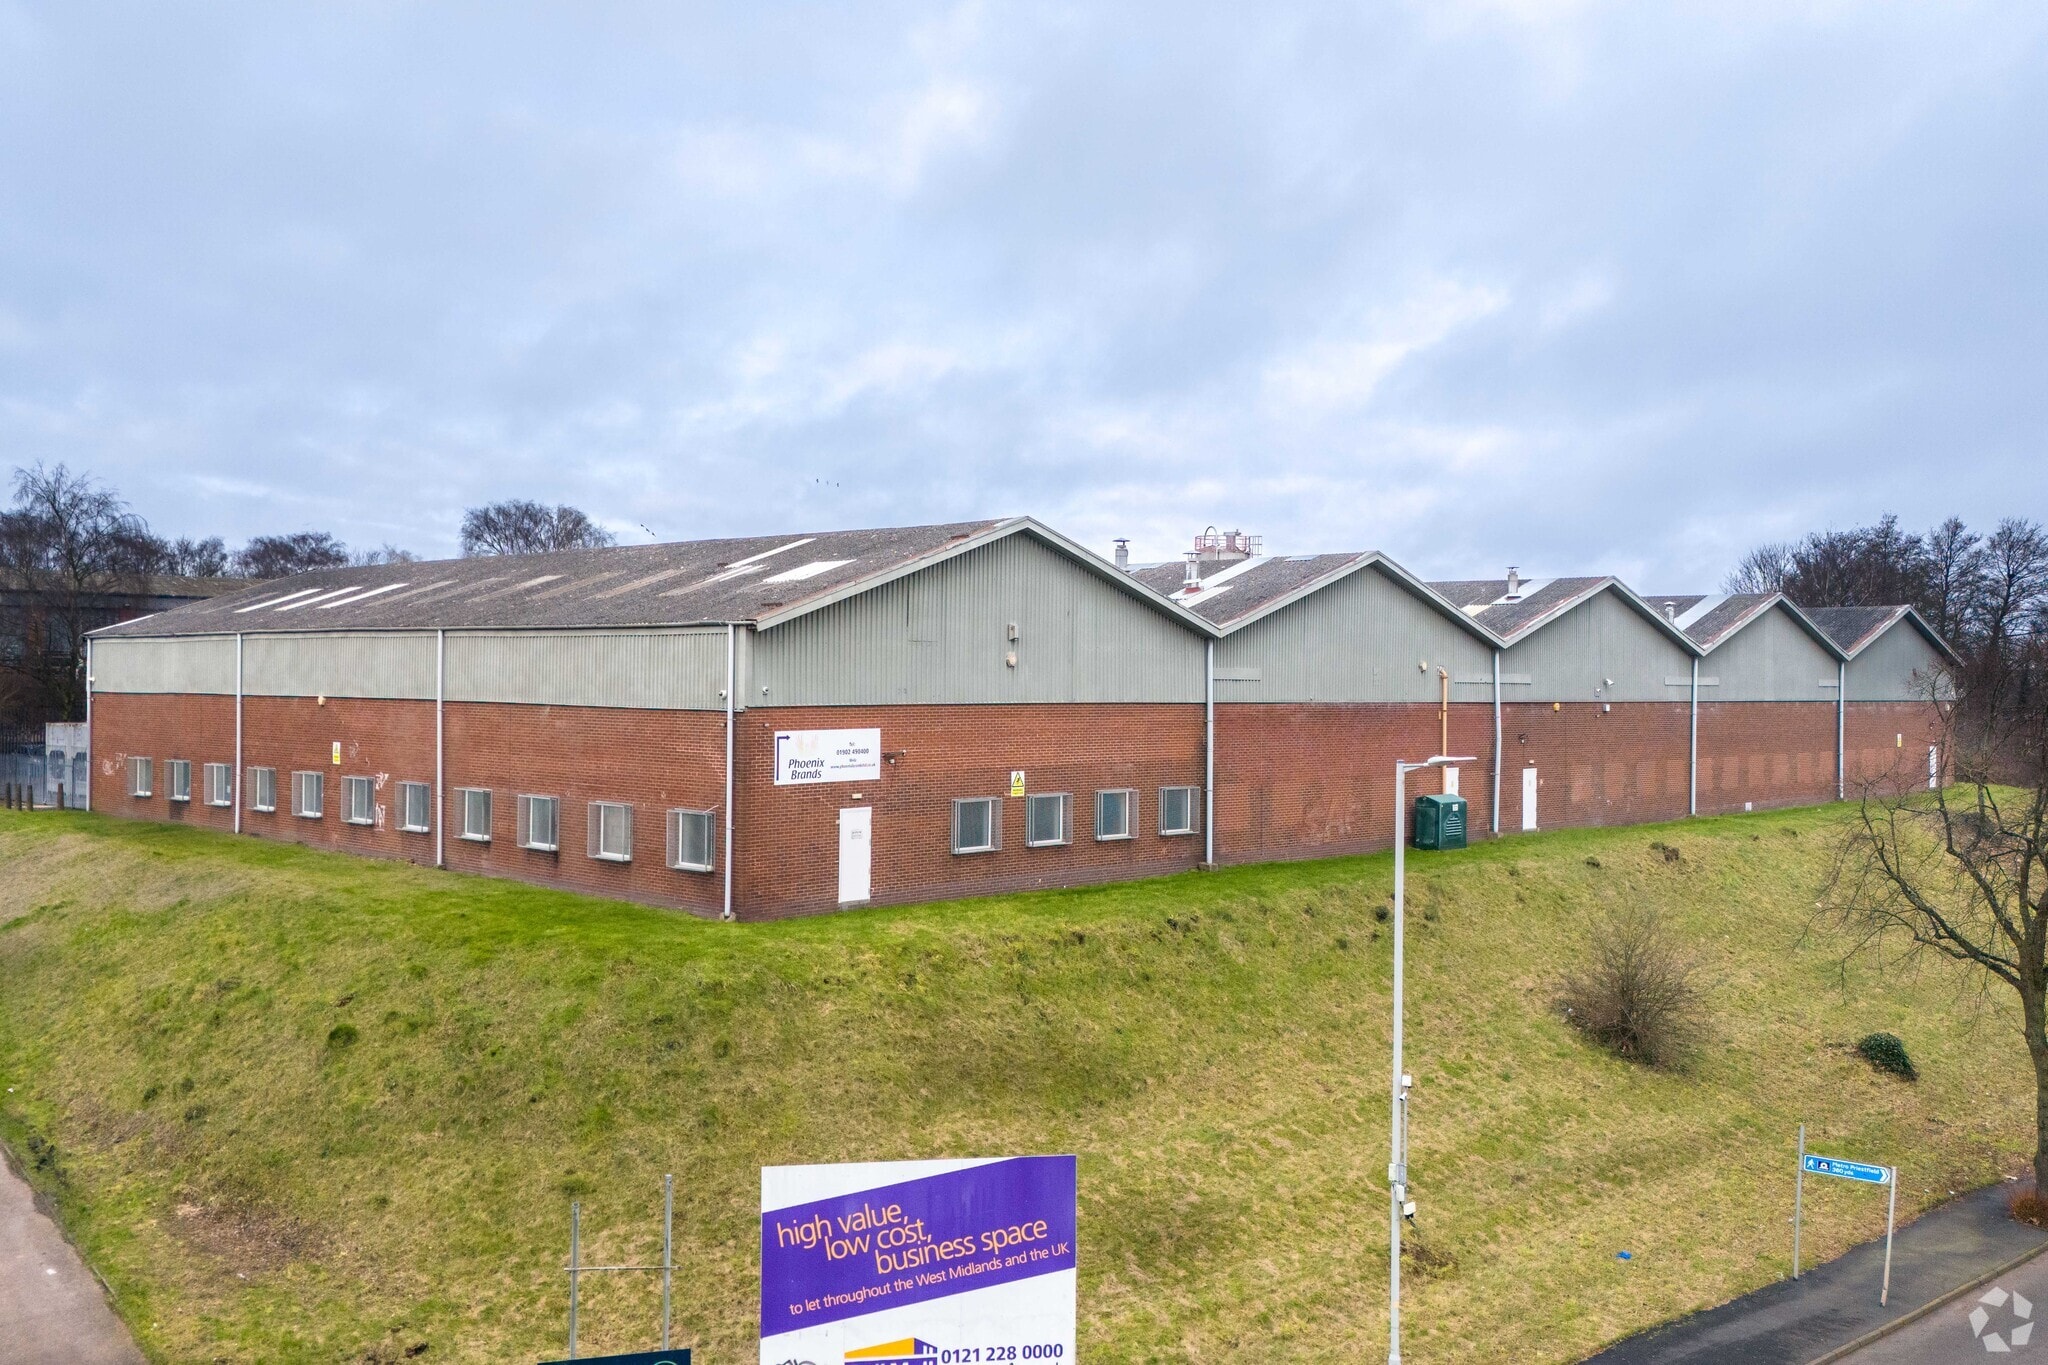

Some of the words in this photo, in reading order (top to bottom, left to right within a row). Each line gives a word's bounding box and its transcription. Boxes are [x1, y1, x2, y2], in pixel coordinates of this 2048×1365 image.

[788, 758, 825, 769] Phoenix
[791, 769, 822, 780] Brands
[1832, 1162, 1849, 1170] Metro
[1850, 1165, 1880, 1174] Priestfield
[777, 1214, 832, 1249] high
[837, 1203, 908, 1234] value,
[825, 1234, 870, 1261] low
[877, 1218, 932, 1249] cost,
[875, 1236, 976, 1274] business
[981, 1220, 1048, 1255] space
[789, 1303, 803, 1315] to
[805, 1298, 821, 1312] let
[823, 1282, 892, 1304] throughout
[893, 1278, 913, 1292] the
[915, 1271, 947, 1287] West
[949, 1257, 1003, 1280] Midlands
[1005, 1251, 1027, 1267] and
[1029, 1248, 1049, 1262] the
[1051, 1241, 1070, 1256] UK
[941, 1348, 980, 1364] 0121
[985, 1346, 1017, 1361] 228
[1022, 1343, 1063, 1360] 0000
